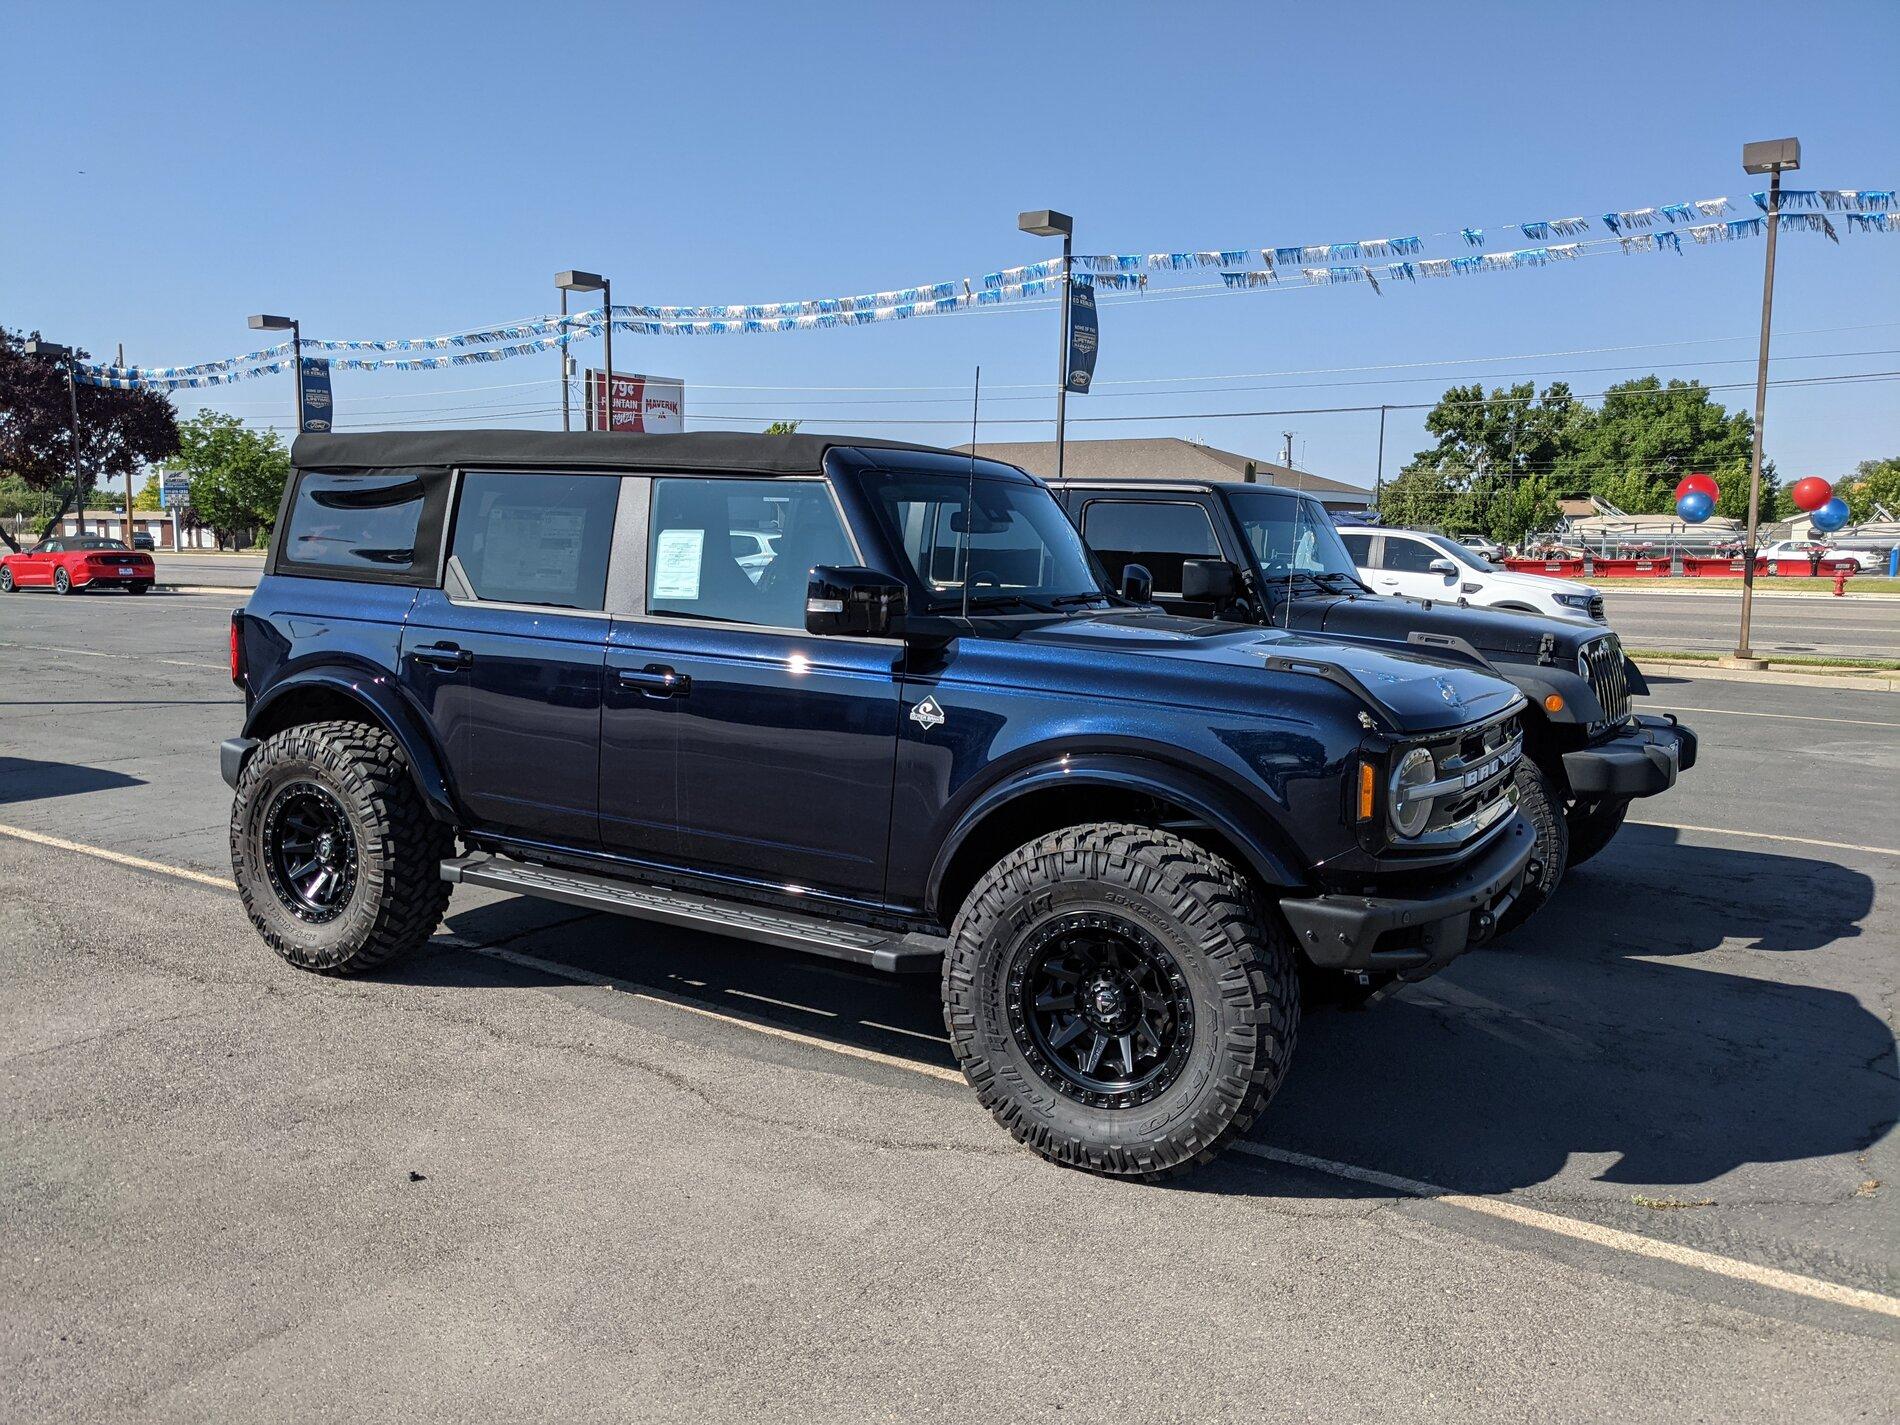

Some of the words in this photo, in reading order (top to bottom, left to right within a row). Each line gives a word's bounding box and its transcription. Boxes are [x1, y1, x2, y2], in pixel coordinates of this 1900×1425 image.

[612, 380, 635, 396] 79¢
[601, 396, 638, 410] FUNTAIN
[645, 398, 678, 415] MAVERIK
[612, 411, 635, 426] renzy
